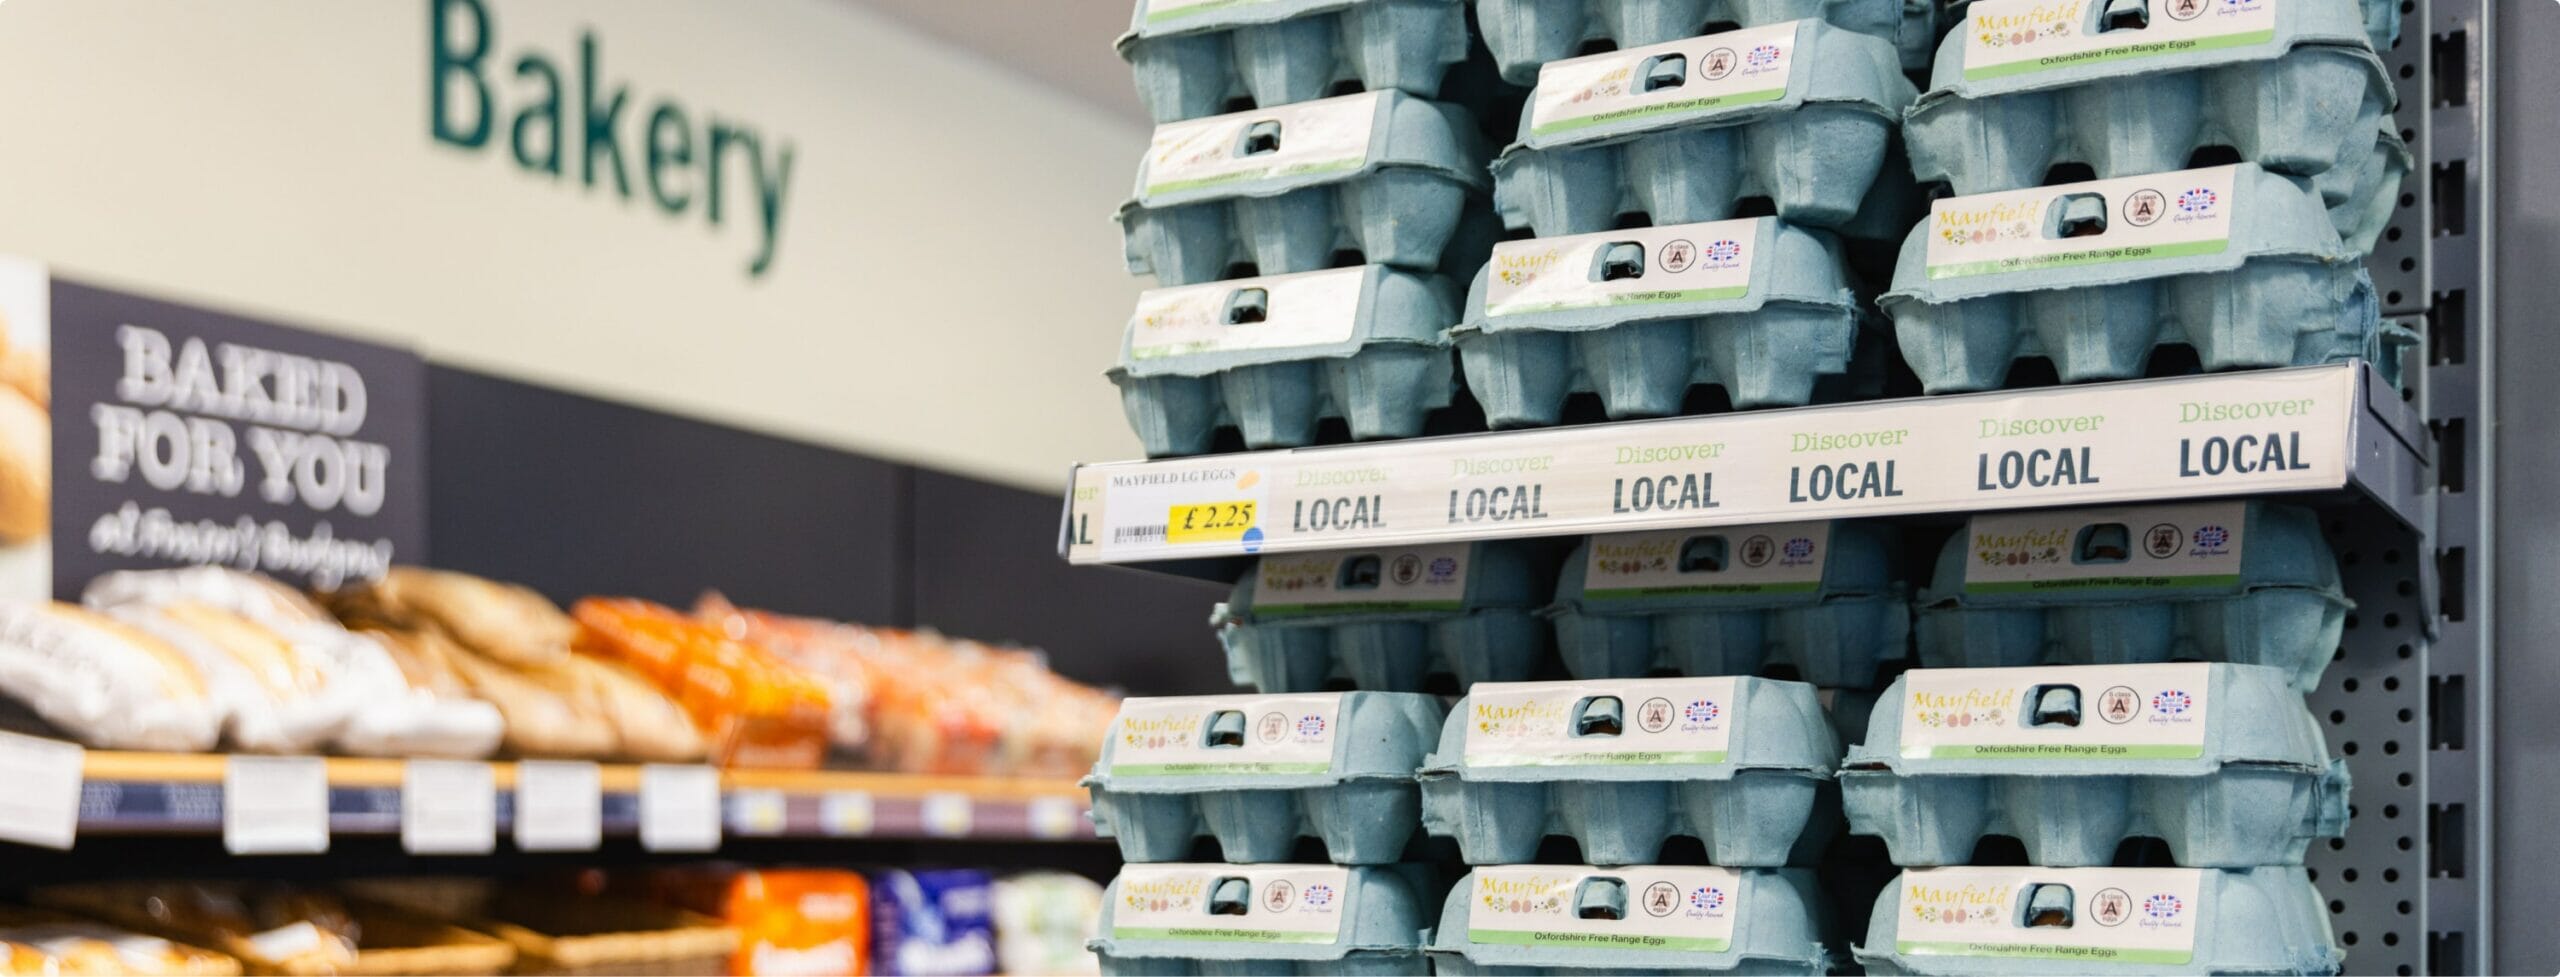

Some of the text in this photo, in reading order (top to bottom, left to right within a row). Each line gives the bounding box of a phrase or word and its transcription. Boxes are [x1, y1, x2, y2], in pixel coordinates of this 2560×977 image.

[1974, 0, 2080, 32] Mayfield
[1712, 58, 1724, 71] A
[2041, 39, 2197, 66] Oxfordshire Free Range Eggs
[1593, 97, 1721, 121] Oxfordshire Free Range Eggs
[432, 0, 794, 276] Bakery
[1936, 200, 2041, 229] Mayfield
[2137, 202, 2151, 216] A
[1671, 251, 1683, 263] A
[2001, 246, 2151, 267] Oxfordshire Free Range Eggs
[1658, 290, 1682, 300] Eggs
[117, 324, 367, 437] BAKED
[2178, 398, 2315, 423] Discover
[1978, 414, 2105, 438] Discover
[1791, 428, 1909, 452] Discover
[91, 402, 390, 516] FOR YOU
[1452, 453, 1552, 477] Discover
[1615, 442, 1725, 465] Discover
[2179, 431, 2311, 477] LOCAL
[1113, 469, 1236, 487] MAYFIELD LG EGGS
[1296, 466, 1391, 487] Discover
[1978, 446, 2100, 490] LOCAL
[1613, 472, 1720, 514] LOCAL
[1789, 460, 1903, 503] LOCAL
[1293, 495, 1387, 533] LOCAL
[1448, 484, 1548, 523] LOCAL
[1183, 504, 1252, 530] £ 2.25
[1976, 528, 2069, 552] Mayfield
[2156, 534, 2171, 549] A
[1912, 687, 2016, 713] Mayfield
[2112, 699, 2126, 713] A
[1649, 710, 1662, 723] A
[1607, 752, 1636, 761] Range
[1638, 752, 1662, 761] Eggs
[1975, 744, 2127, 755] Oxfordshire Free Range Eggs
[1273, 891, 1284, 903] A
[1655, 894, 1667, 907] A
[1909, 884, 2009, 910] Mayfield
[2103, 901, 2117, 915] A
[1169, 928, 1281, 939] Oxfordshire Free Range Eggs
[1534, 931, 1666, 946] Oxfordshire Free Range Eggs
[1969, 943, 2118, 957] Oxfordshire Free Range Eggs
